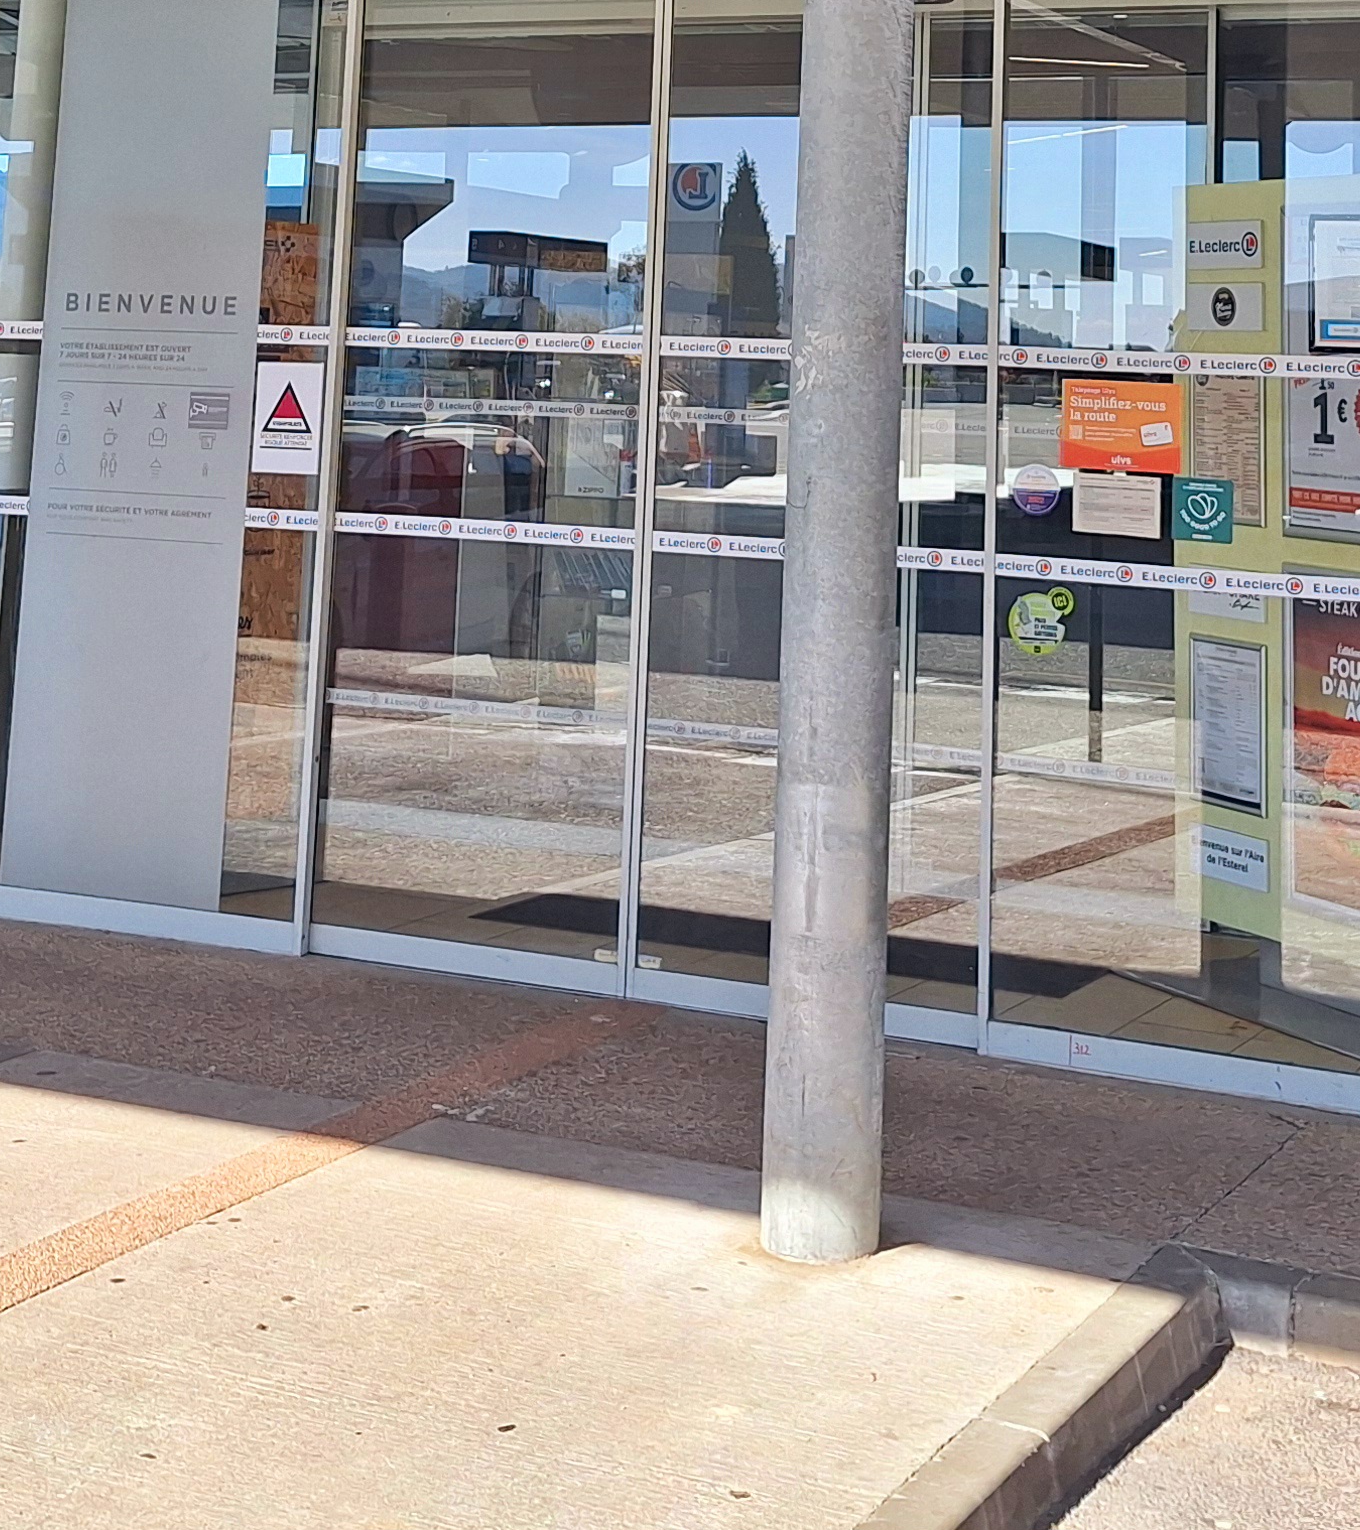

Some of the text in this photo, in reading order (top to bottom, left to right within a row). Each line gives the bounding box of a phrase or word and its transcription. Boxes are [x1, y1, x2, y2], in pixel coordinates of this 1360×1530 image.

[1189, 240, 1241, 254] E.Leclerc
[65, 292, 238, 316] BIENVENUE
[10, 325, 43, 335] E.Lecler
[257, 329, 329, 340] clerc E.Lecl
[345, 332, 387, 342] E.Leclerc
[407, 334, 450, 345] E.Leclerc
[470, 336, 514, 346] E.Leclerc
[535, 338, 580, 348] E.Leclerc
[60, 342, 84, 350] VOTRE
[145, 344, 160, 352] EST
[161, 344, 192, 353] OUVERT
[669, 342, 787, 354] E.Leclerc E.Leclerc
[159, 354, 174, 362] SUR
[176, 354, 185, 362] 24
[903, 349, 988, 361] clerc E.Lec
[1036, 353, 1090, 365] E.Leclerc
[1116, 357, 1172, 368] E.Leclerc
[1200, 359, 1257, 371] E.Leclerc
[1286, 362, 1345, 374] E.Leclerc
[345, 399, 375, 408] Leclerc
[488, 403, 523, 412] E.Leclerc
[590, 407, 625, 417] E.Leclerc
[1069, 395, 1167, 412] Simplifiez-vous
[1070, 409, 1117, 422] la route
[955, 422, 986, 432] E.Lecle
[70, 504, 93, 512] VOTRE
[133, 507, 141, 515] ET
[245, 514, 318, 526] clerc E.Lecle
[338, 518, 374, 529] Leclerc
[394, 520, 438, 532] E.Leclerc
[459, 524, 503, 536] E.Leclerc
[524, 528, 569, 540] E.Leclerc
[659, 537, 778, 554] E.Leclerc E.Leclerc
[897, 553, 984, 567] clerc E.Lecl
[994, 560, 1035, 573] eclerc
[1060, 565, 1115, 579] E.Leclerc
[1142, 571, 1198, 585] E.Leclerc
[1225, 577, 1285, 591] E.Leclerc
[1053, 595, 1067, 608] ICI
[1318, 599, 1358, 618] STEAK
[1231, 847, 1265, 863] sur l'Aire
[1206, 854, 1249, 873] de l'Esterel
